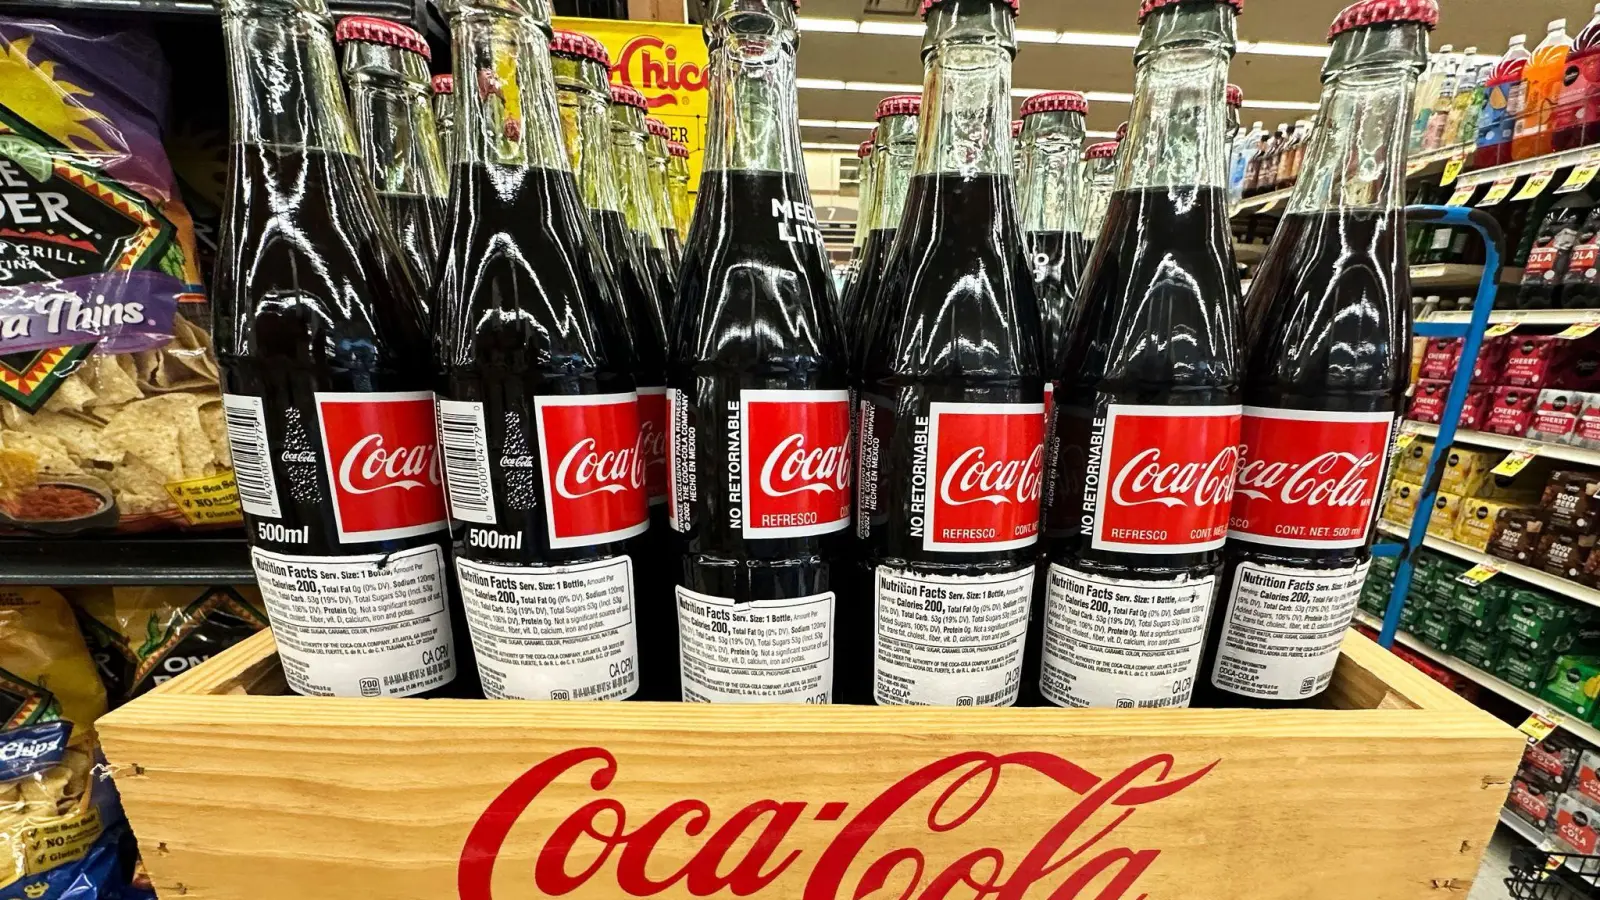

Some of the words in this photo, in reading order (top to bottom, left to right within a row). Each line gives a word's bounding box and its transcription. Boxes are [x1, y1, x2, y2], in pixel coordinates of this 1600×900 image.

[827, 207, 836, 220] 7
[35, 293, 144, 333] Thins
[681, 393, 689, 436] COMPANY
[1494, 407, 1522, 416] CHERRY
[1540, 416, 1568, 425] CHERRY
[688, 426, 696, 460] MEXICO
[727, 401, 741, 503] RETORNABLE
[871, 437, 880, 469] MEXICO
[689, 460, 696, 473] EN
[911, 416, 929, 512] RETORNABLE
[1082, 417, 1106, 512] RETORNABLE
[871, 470, 878, 482] EN
[689, 473, 697, 502] HECHO
[1556, 499, 1577, 509] BEER
[1557, 492, 1579, 503] ROOT
[729, 508, 742, 529] NO
[762, 512, 817, 526] REFRESCO
[911, 514, 924, 537] NO
[1081, 516, 1094, 536] NO
[258, 522, 309, 544] 500ml
[943, 528, 995, 539] REFRESCO
[1111, 528, 1168, 540] REFRESCO
[1275, 524, 1306, 536] CONT.
[1310, 526, 1331, 537] NET.
[1333, 526, 1351, 537] 500
[1503, 529, 1522, 539] ROOT
[470, 529, 522, 550] 500ml
[1552, 542, 1572, 553] ROOT
[288, 565, 318, 579] Facts
[320, 571, 340, 580] Serv.
[341, 571, 360, 580] Size:
[361, 571, 365, 579] 1
[296, 580, 321, 595] 200,
[323, 585, 339, 593] Total
[340, 585, 351, 593] Fat
[490, 576, 517, 590] Facts
[519, 582, 537, 590] Serv.
[538, 582, 555, 590] Size:
[556, 582, 560, 590] 1
[563, 580, 586, 590] Bottle,
[881, 577, 917, 596] Nutrition
[919, 585, 946, 599] Facts
[948, 591, 965, 600] Serv.
[966, 591, 981, 600] Size:
[982, 591, 986, 599] 1
[1051, 573, 1084, 595] Nutrition
[1086, 585, 1113, 600] Facts
[1115, 593, 1132, 602] Serv.
[1133, 594, 1149, 603] Size:
[1151, 595, 1155, 603] 1
[1243, 571, 1286, 590] Nutrition
[1287, 579, 1315, 591] Facts
[497, 591, 519, 605] 200,
[520, 596, 536, 604] Total
[537, 596, 548, 604] Fat
[1065, 594, 1090, 609] Calories
[1090, 599, 1112, 615] 200,
[1260, 590, 1289, 602] Calories
[1290, 592, 1311, 604] 200,
[324, 605, 347, 614] Protein
[896, 597, 923, 610] Calories
[924, 600, 946, 615] 200,
[521, 617, 543, 625] Protein
[706, 606, 730, 620] Facts
[732, 613, 748, 622] Serv.
[750, 614, 765, 623] Size:
[766, 614, 770, 622] 1
[772, 613, 793, 623] Bottle,
[711, 620, 731, 636] 200,
[943, 625, 963, 634] Protein
[422, 649, 434, 666] CA
[608, 663, 620, 678] CA
[361, 679, 377, 688] 200
[553, 692, 567, 700] 200
[458, 747, 1222, 900] Coca-Cola
[47, 836, 65, 848] NO
[1560, 825, 1587, 846] COLA
